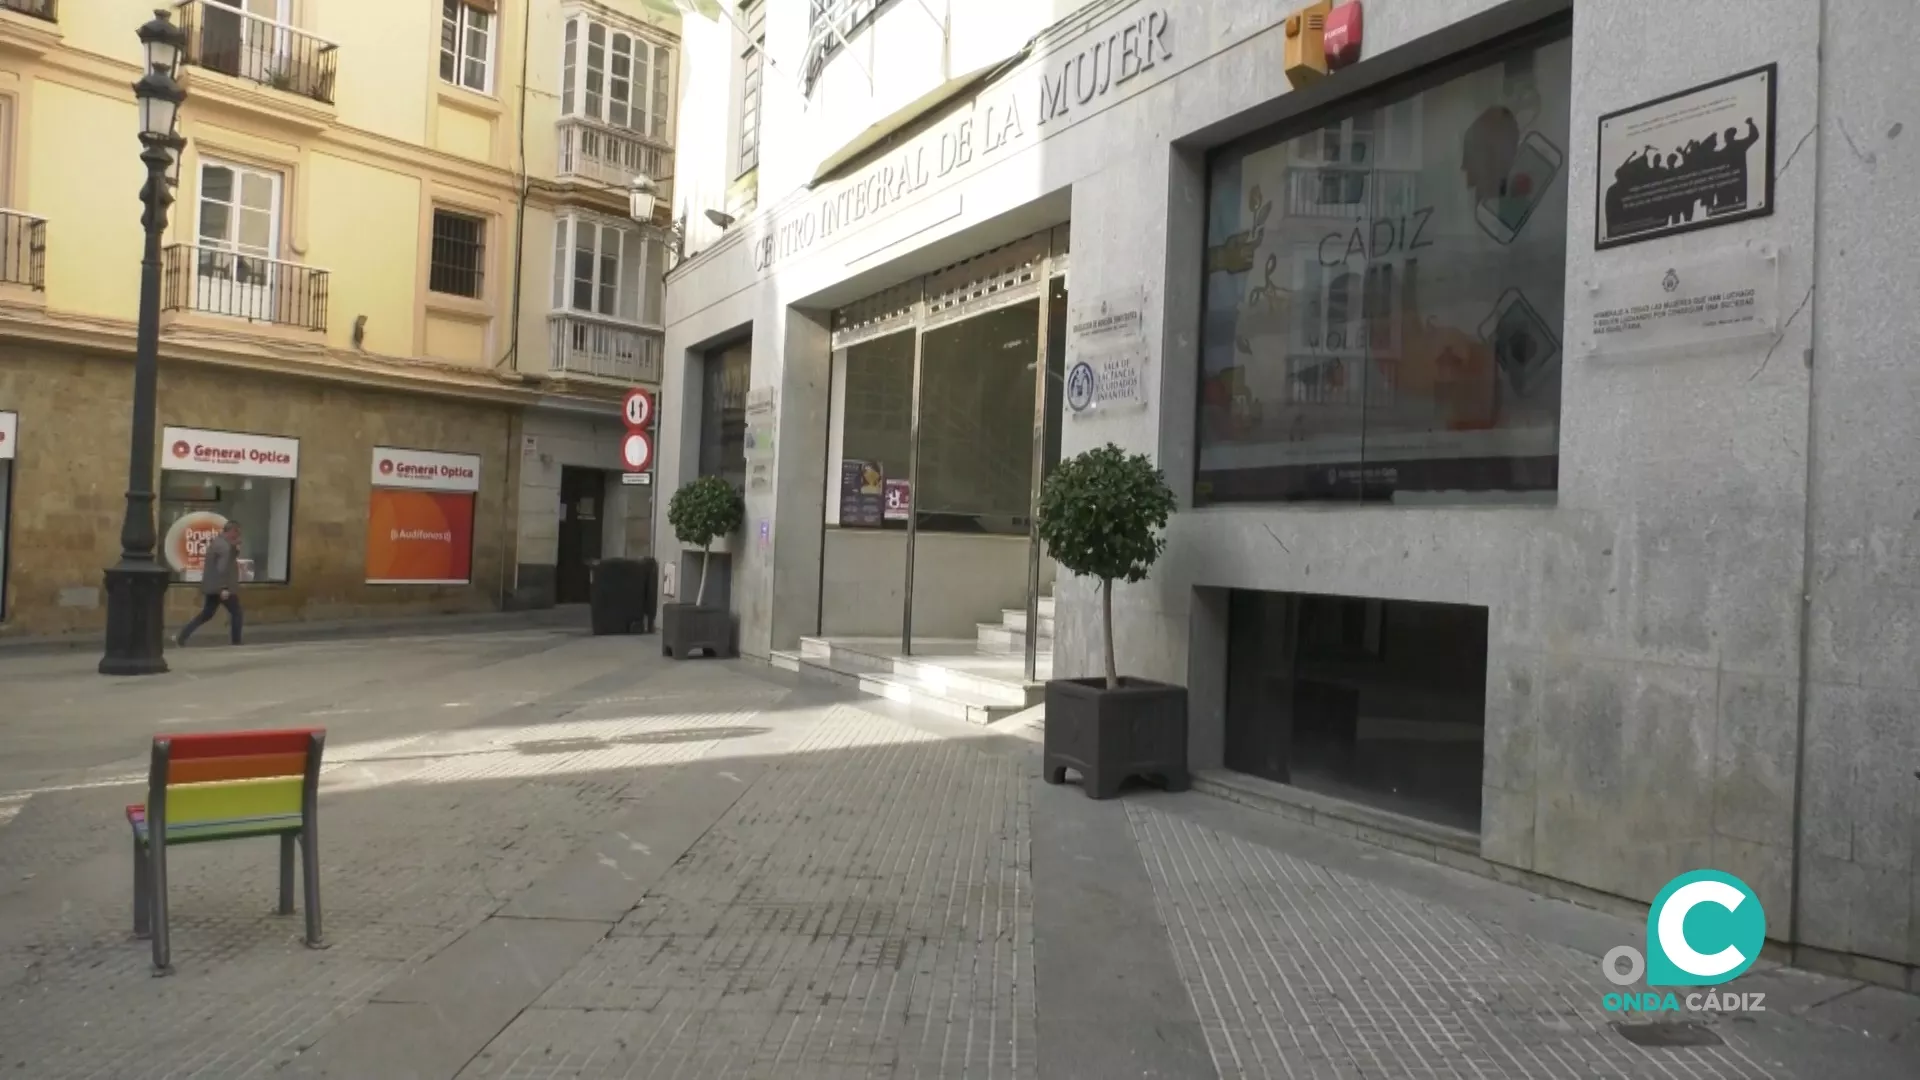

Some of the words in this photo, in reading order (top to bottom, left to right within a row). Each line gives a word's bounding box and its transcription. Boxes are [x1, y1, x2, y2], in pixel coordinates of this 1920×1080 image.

[754, 211, 815, 272] CENTRO
[820, 146, 929, 239] INTEGRAL
[937, 116, 973, 177] DE
[983, 92, 1024, 156] LA
[1037, 8, 1172, 126] MUJER
[1318, 205, 1435, 267] CÁDIZ
[1103, 359, 1119, 370] SALA
[1121, 358, 1130, 368] DE
[1097, 388, 1134, 402] INFANTILES
[194, 443, 246, 460] General
[249, 448, 290, 464] Optica
[396, 462, 438, 476] General
[441, 465, 473, 478] Optica
